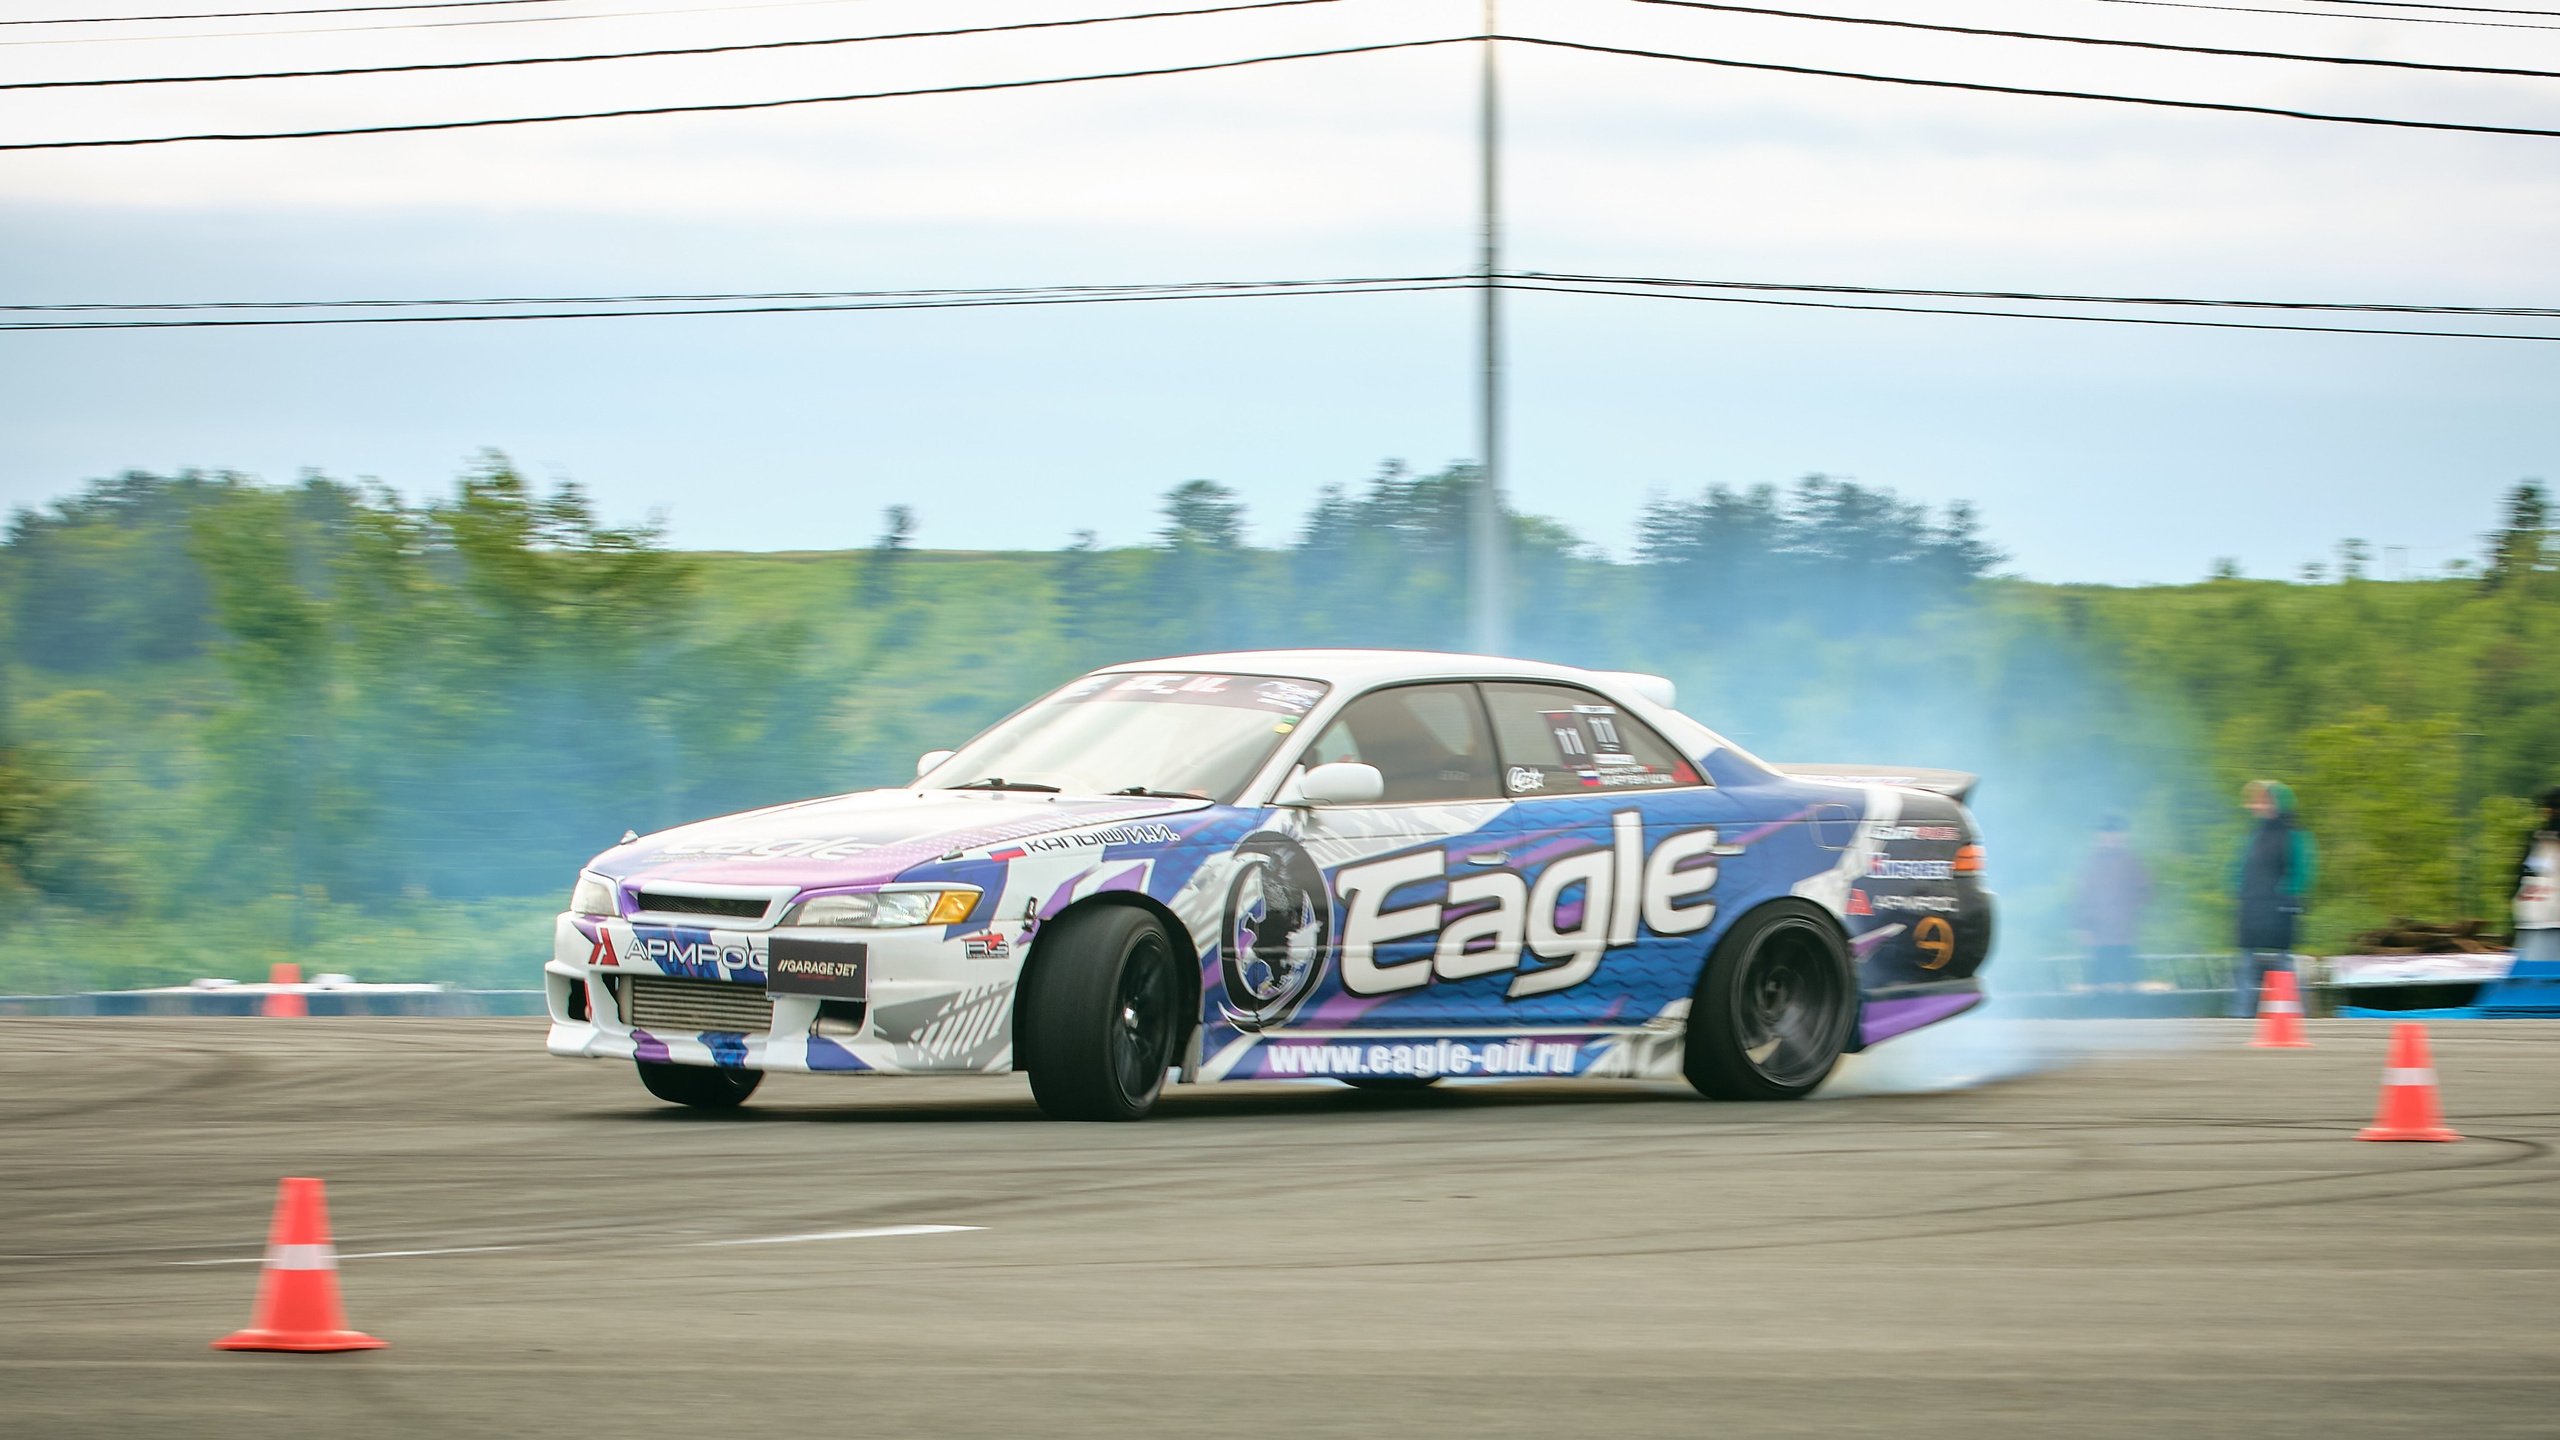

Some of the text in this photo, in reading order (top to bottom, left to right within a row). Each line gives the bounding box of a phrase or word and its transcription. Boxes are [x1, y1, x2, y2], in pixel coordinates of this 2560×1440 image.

[1335, 808, 1718, 999] Eagle
[835, 963, 858, 978] JET
[1267, 1038, 1579, 1078] www.eagle-oil.ru
